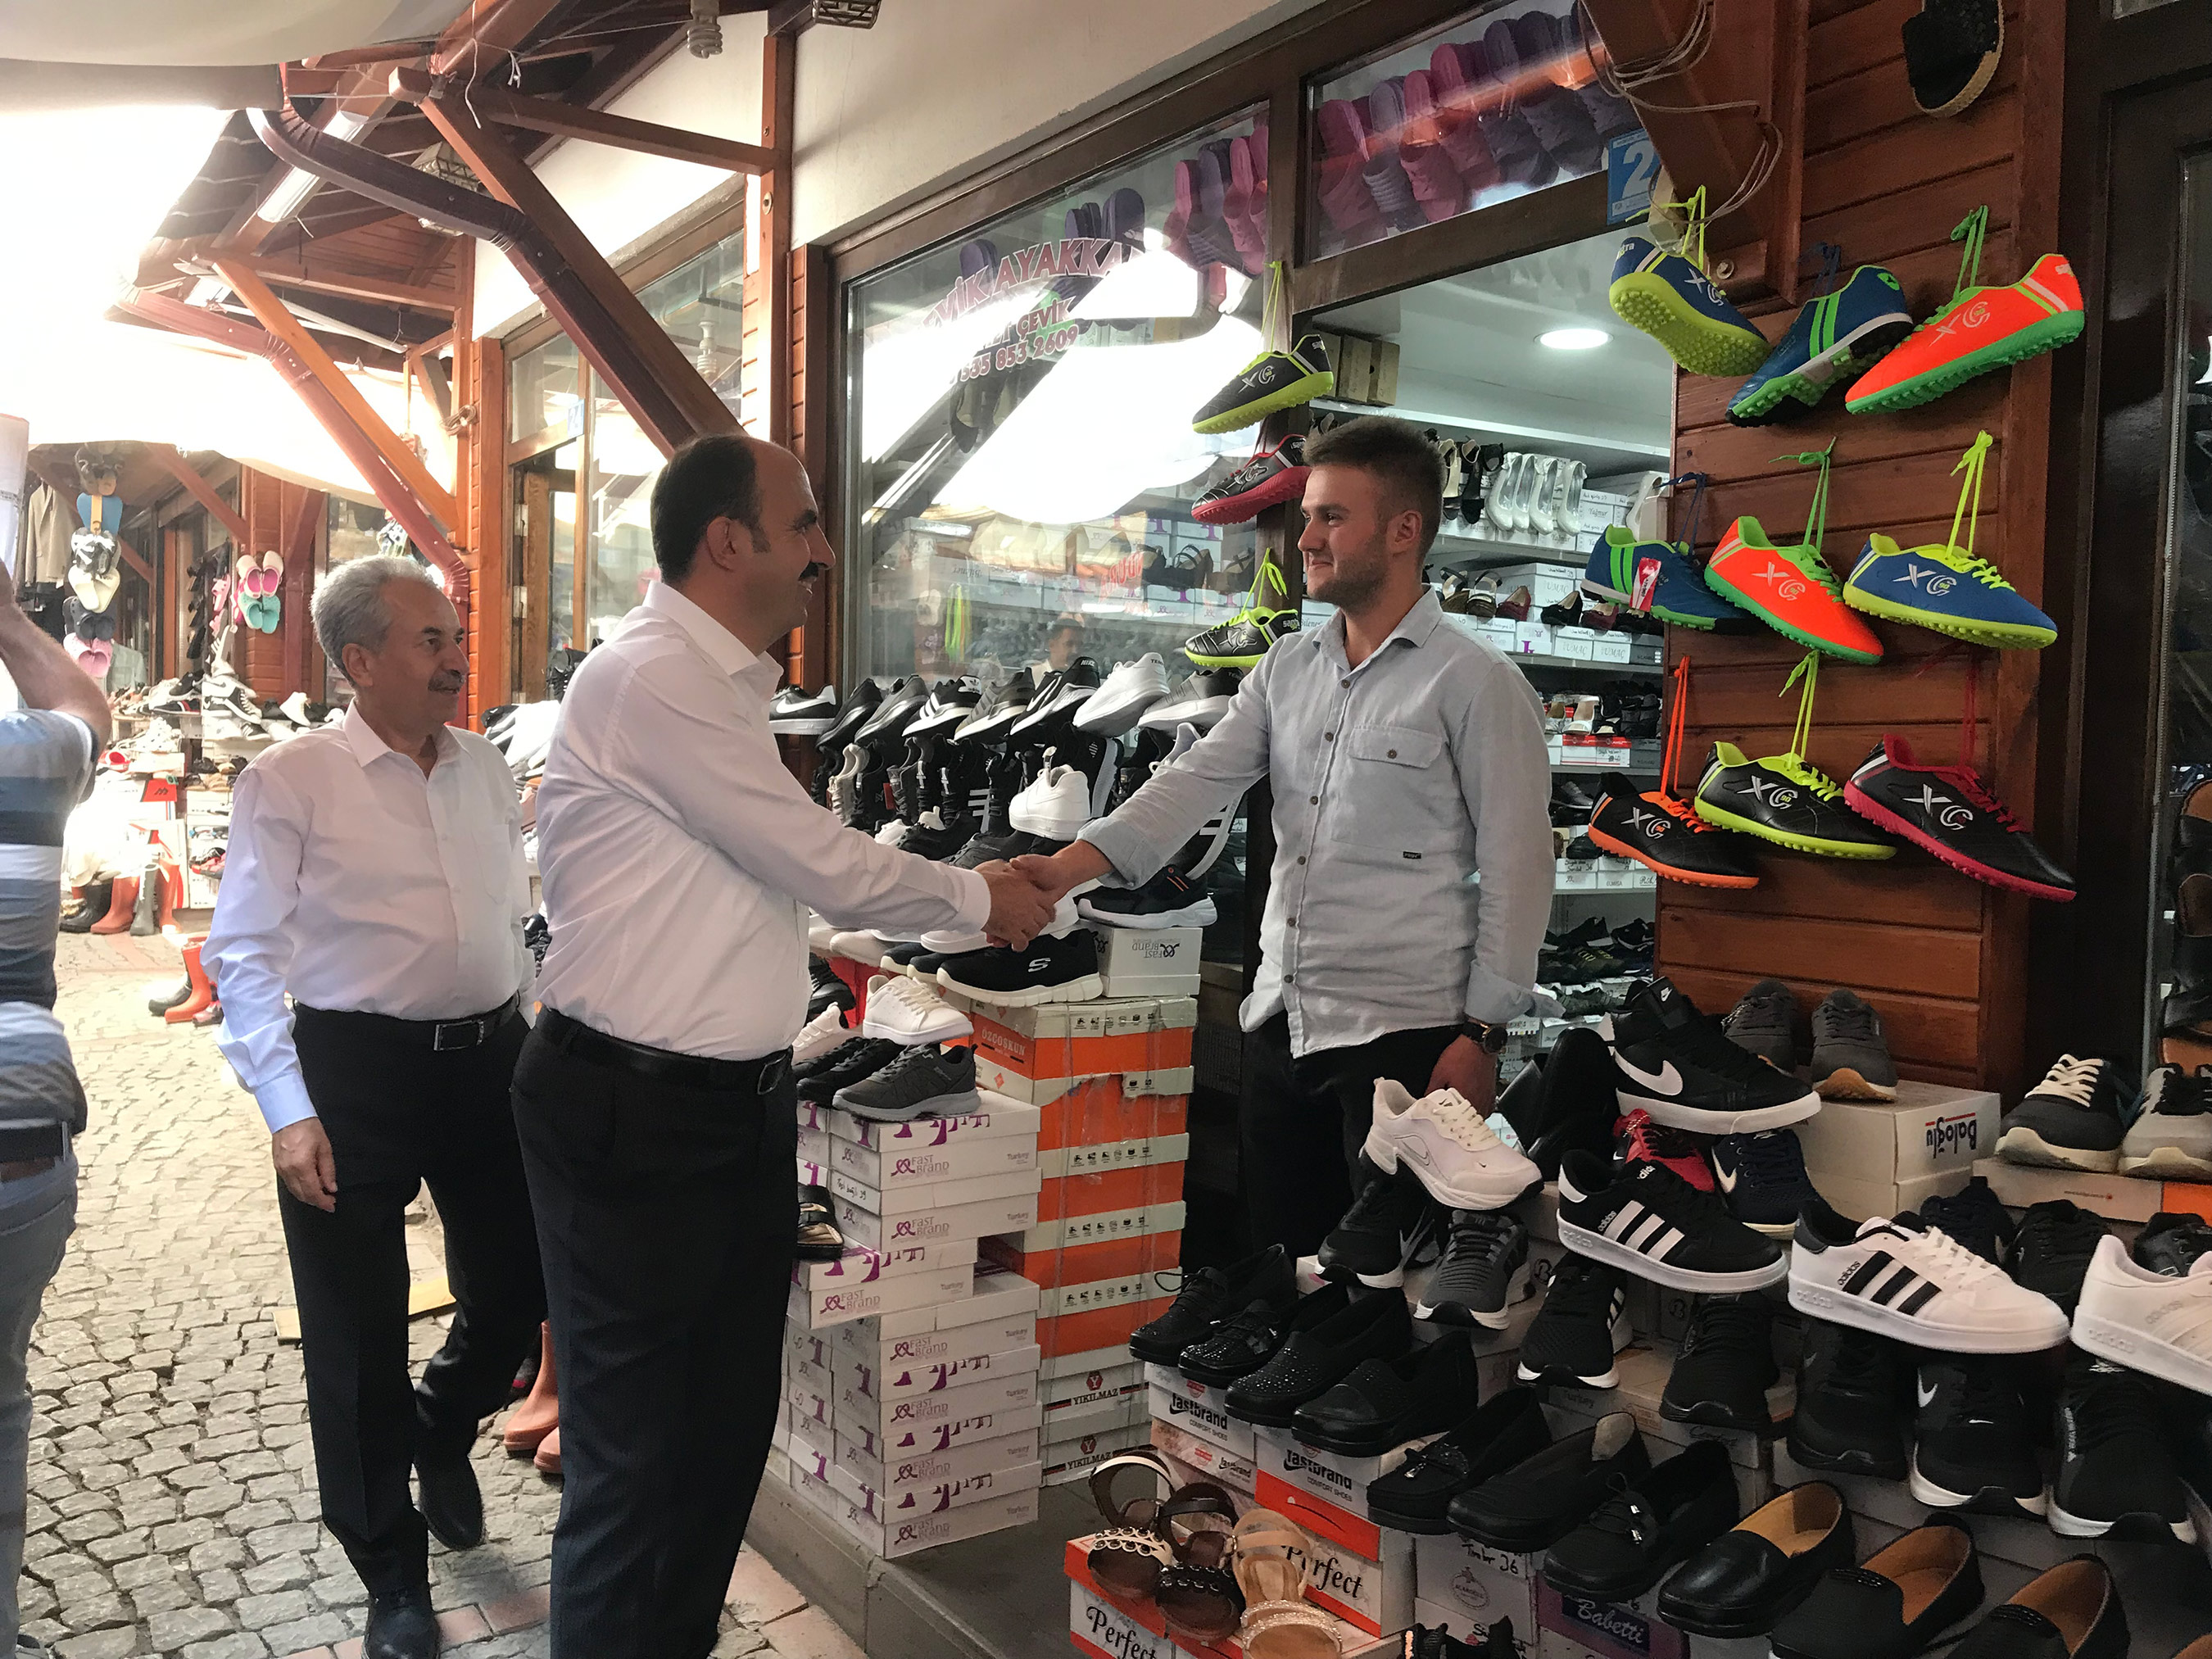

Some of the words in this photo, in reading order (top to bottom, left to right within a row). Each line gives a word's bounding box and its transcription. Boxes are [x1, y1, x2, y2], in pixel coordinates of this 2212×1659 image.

[1621, 140, 1655, 199] 2
[991, 237, 1145, 297] AYAKKA
[995, 341, 1027, 371] 853
[1033, 324, 1079, 360] 2609
[1080, 659, 1095, 667] NIKE
[1598, 1210, 1617, 1231] adidas
[1837, 1261, 1861, 1285] adidas
[1072, 1388, 1118, 1405] YIKILMAZ
[1067, 1452, 1112, 1471] YIKILMAZ
